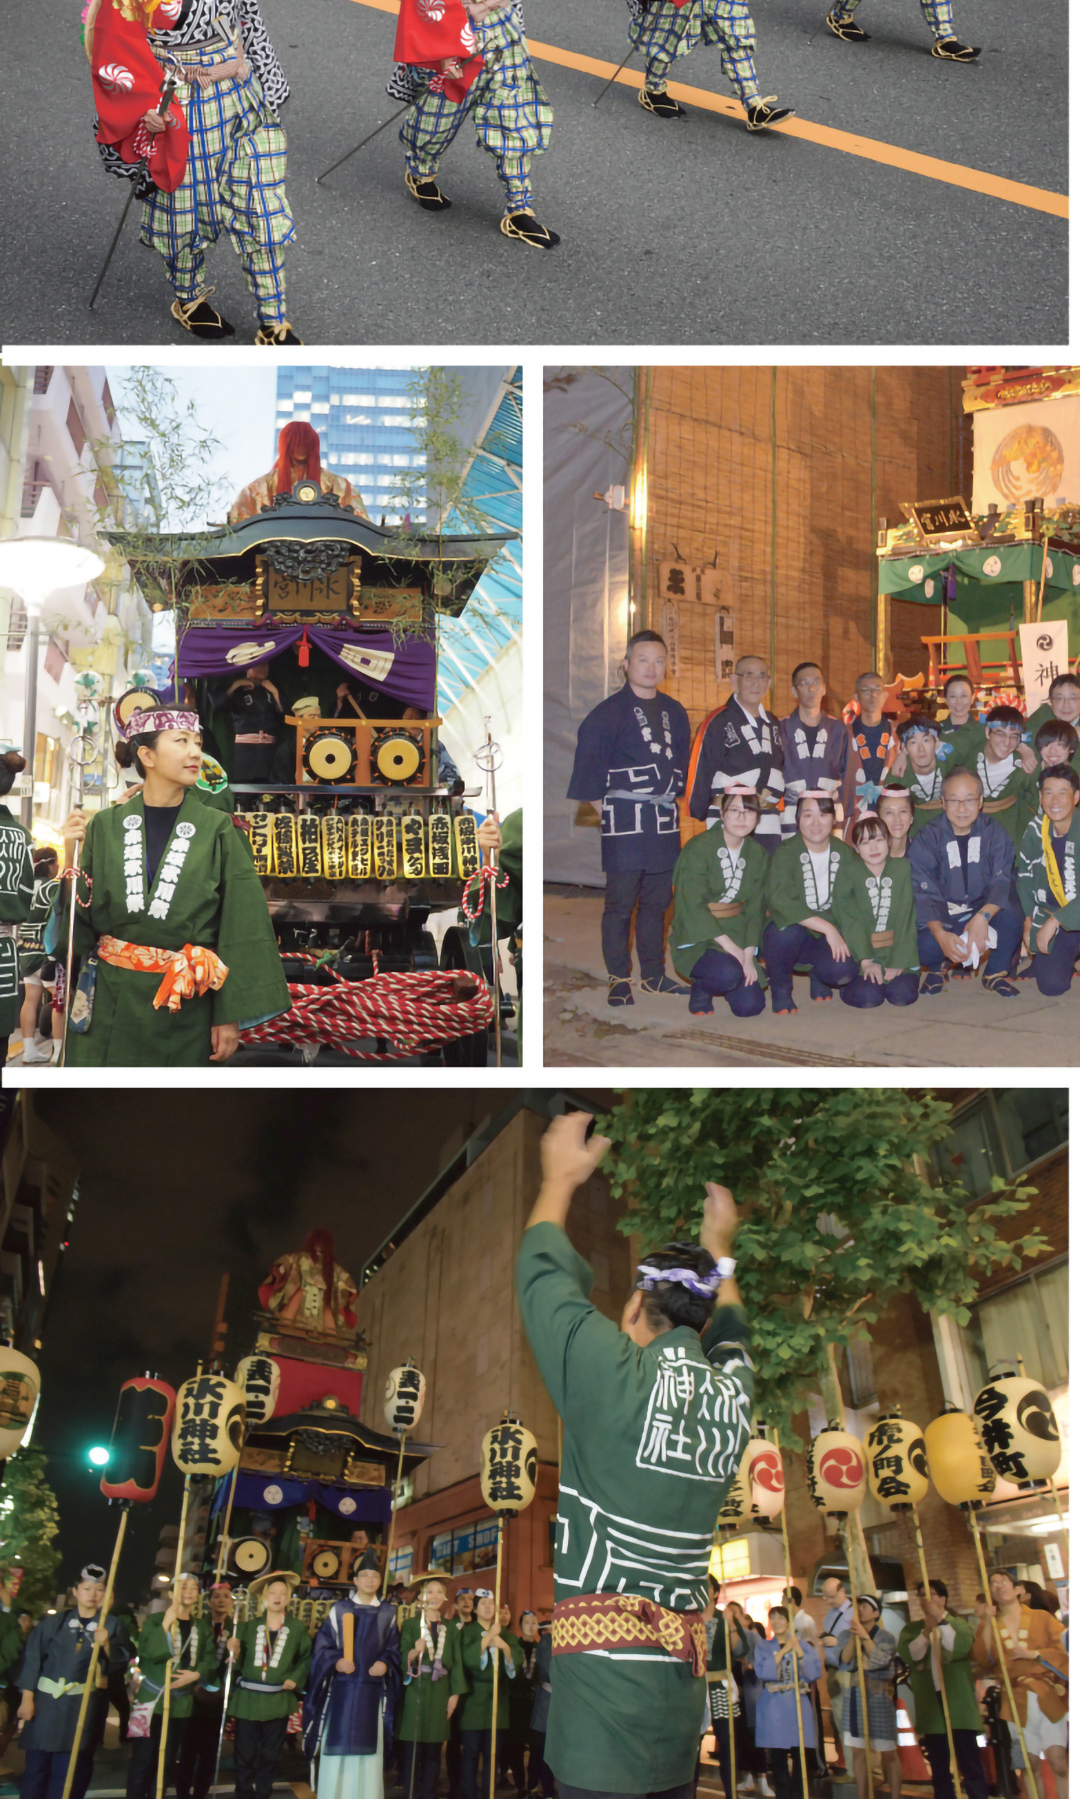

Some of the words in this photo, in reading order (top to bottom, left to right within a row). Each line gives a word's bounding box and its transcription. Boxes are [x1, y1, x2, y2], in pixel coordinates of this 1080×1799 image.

[300, 817, 320, 875] 柏屋
[177, 1376, 227, 1465] 氷川神社
[973, 1386, 1030, 1480] 今井町
[487, 1425, 524, 1502] 氷川神社
[868, 1421, 911, 1498] 虎ノ門会
